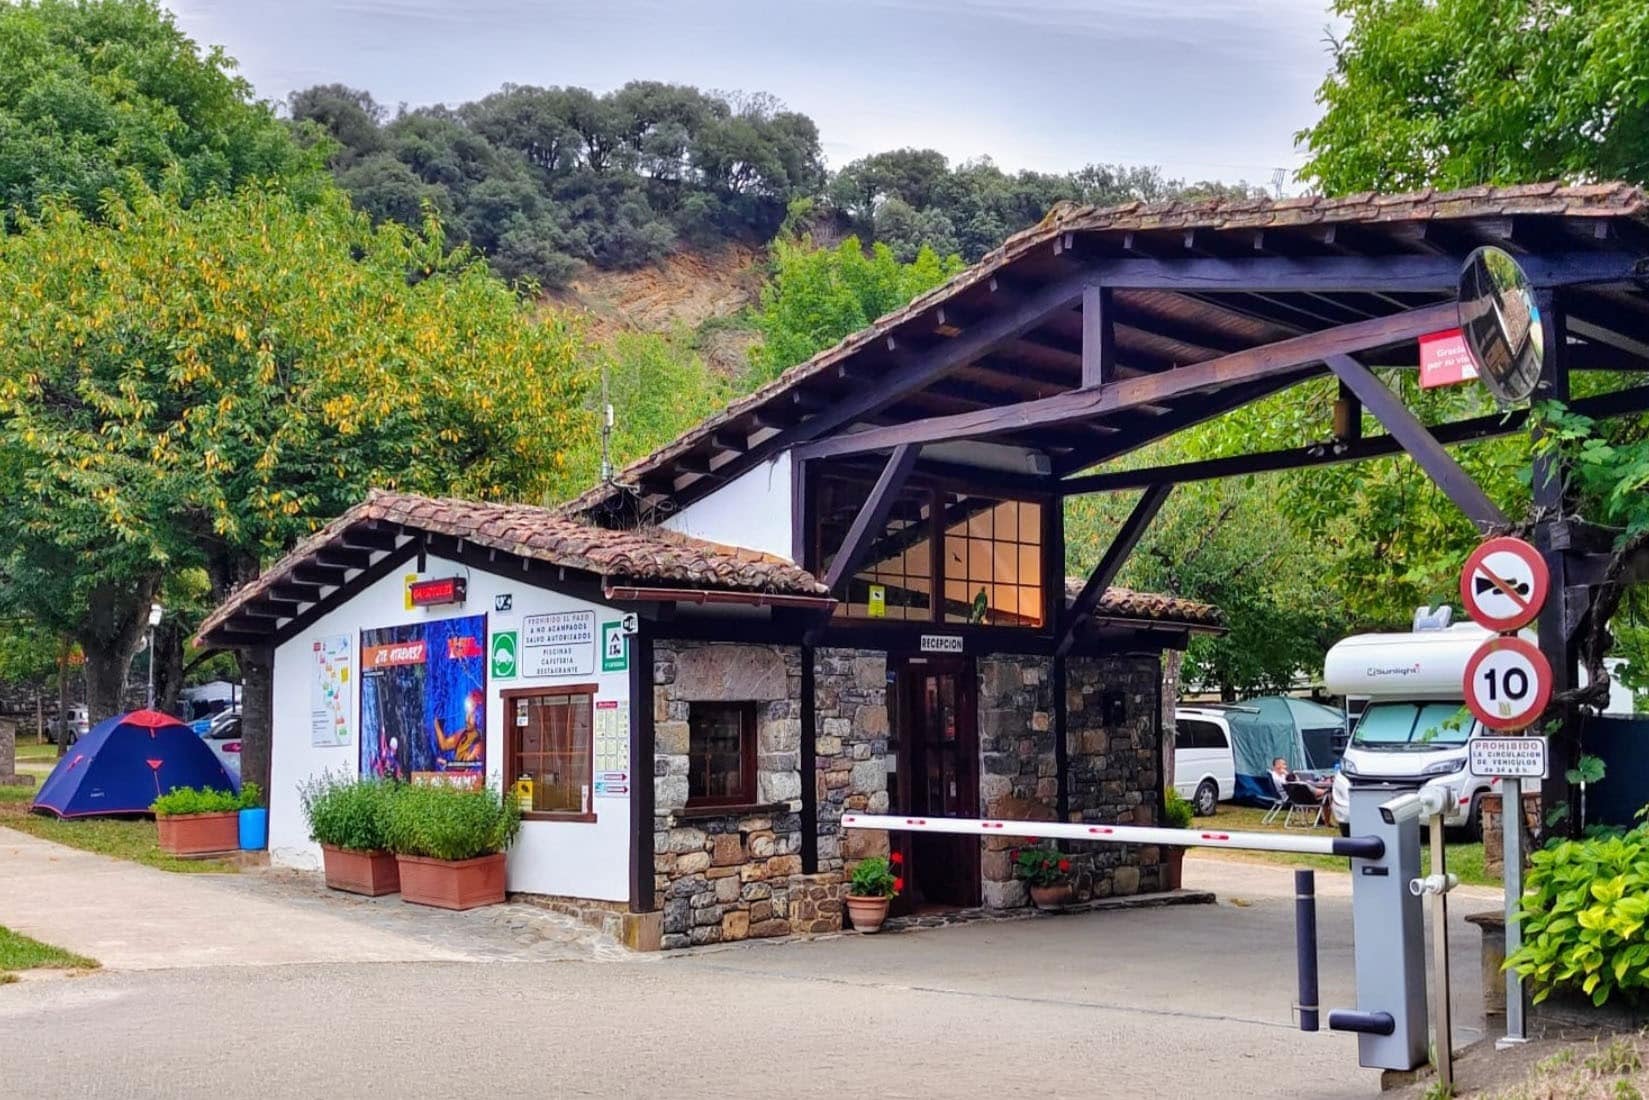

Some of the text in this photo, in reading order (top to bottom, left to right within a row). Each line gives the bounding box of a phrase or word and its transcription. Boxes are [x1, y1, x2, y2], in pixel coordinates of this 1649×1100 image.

[1437, 346, 1466, 357] Gracia
[528, 616, 560, 625] PROHIBIDO
[572, 614, 589, 622] PASO
[549, 623, 587, 632] ACAMPADOS
[547, 632, 591, 642] AUTORIZADOS
[922, 637, 962, 649] RECEPCION
[543, 647, 572, 656] PISCINAS
[541, 657, 573, 665] CAFETERIA
[537, 666, 578, 674] RESTAURANTE
[1484, 667, 1529, 700] 10
[1475, 742, 1538, 750] PROHIBIDO
